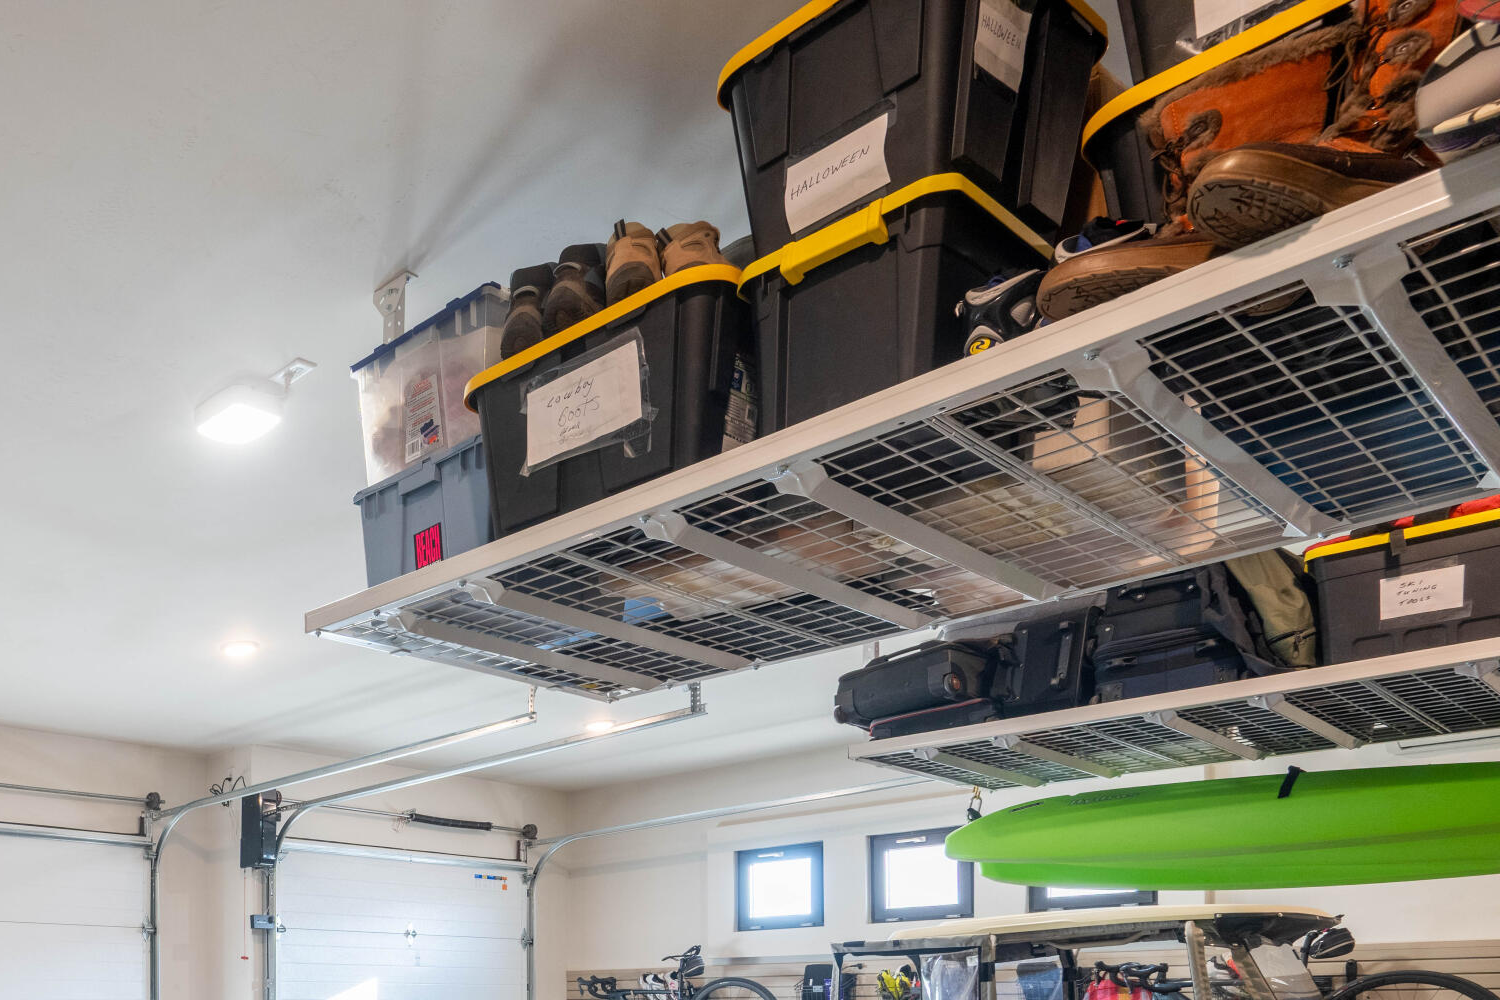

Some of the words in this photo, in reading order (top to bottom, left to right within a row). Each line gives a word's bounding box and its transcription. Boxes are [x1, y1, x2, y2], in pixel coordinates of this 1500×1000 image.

[790, 145, 870, 200] HALLOWEEN
[415, 523, 441, 569] BEACH
[1396, 584, 1437, 596] TUNING
[1399, 580, 1423, 589] SKI
[1398, 596, 1432, 606] TOOLS
